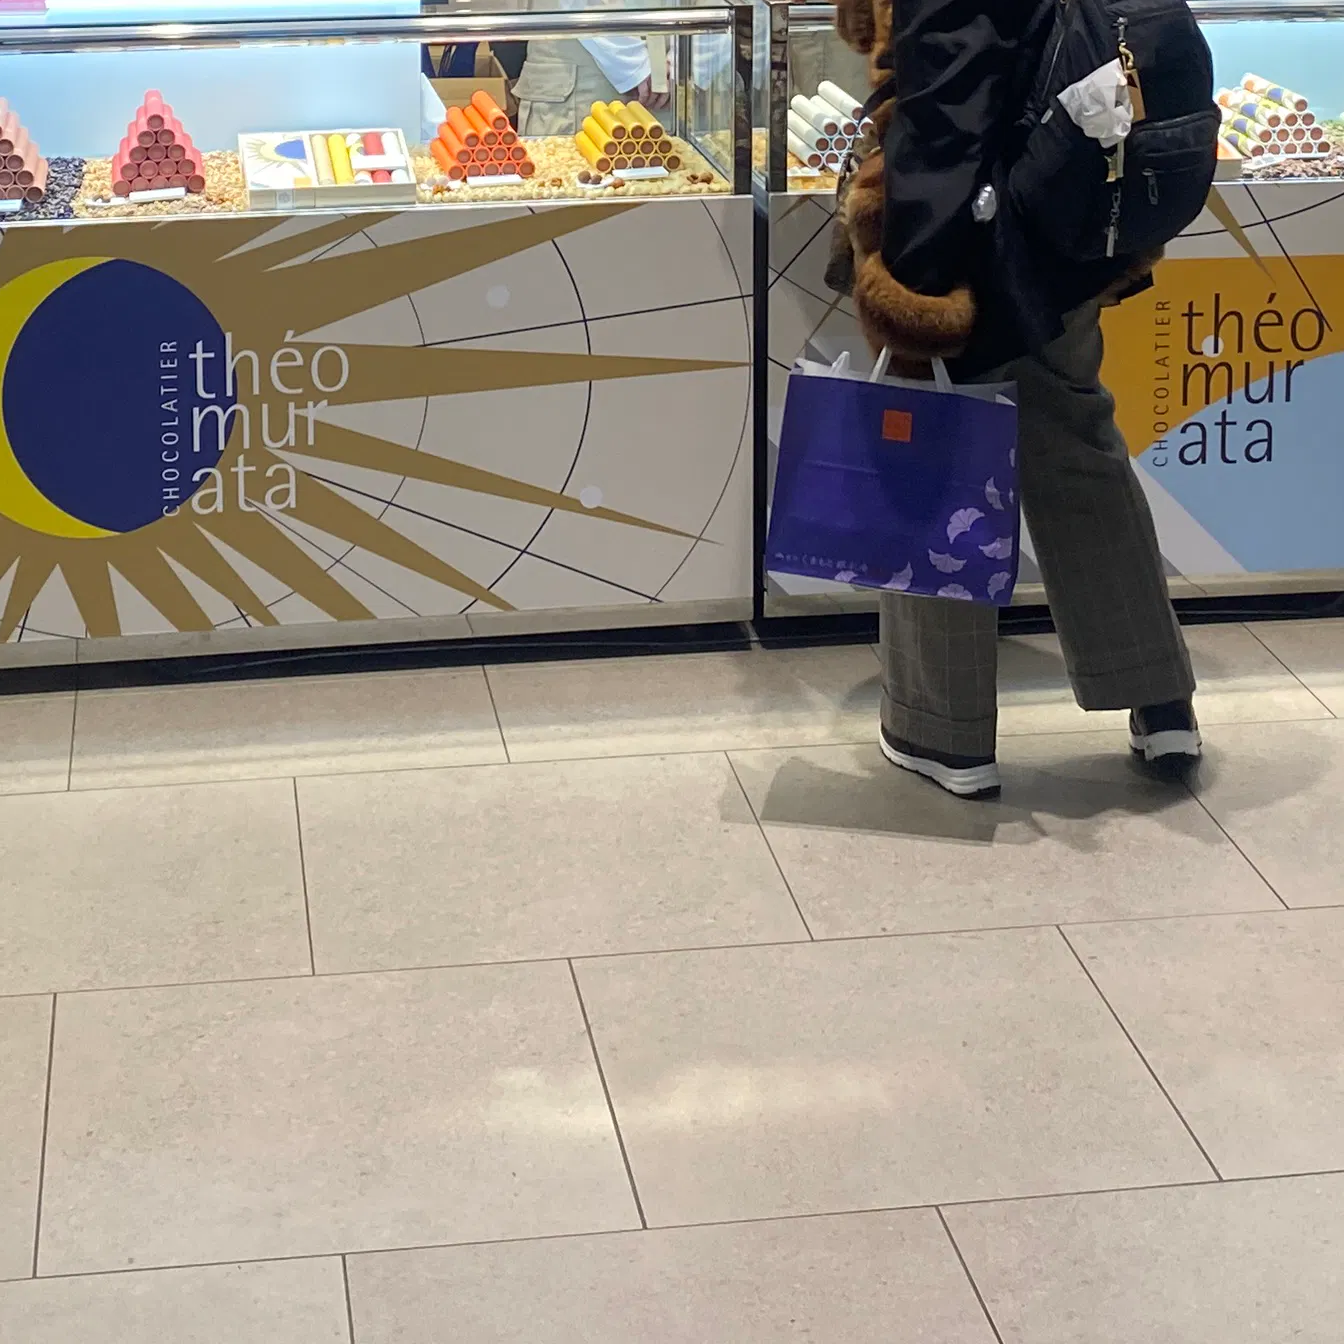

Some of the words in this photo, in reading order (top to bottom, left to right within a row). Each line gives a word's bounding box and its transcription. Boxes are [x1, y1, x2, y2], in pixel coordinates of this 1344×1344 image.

[1181, 292, 1325, 356] théo
[188, 329, 350, 399] théo
[1152, 300, 1171, 468] CHOCOLATIER
[1182, 358, 1305, 407] mur
[159, 341, 180, 517] CHOCOLATIER
[192, 399, 328, 453] mur
[1178, 409, 1273, 466] ata
[191, 454, 297, 515] ata
